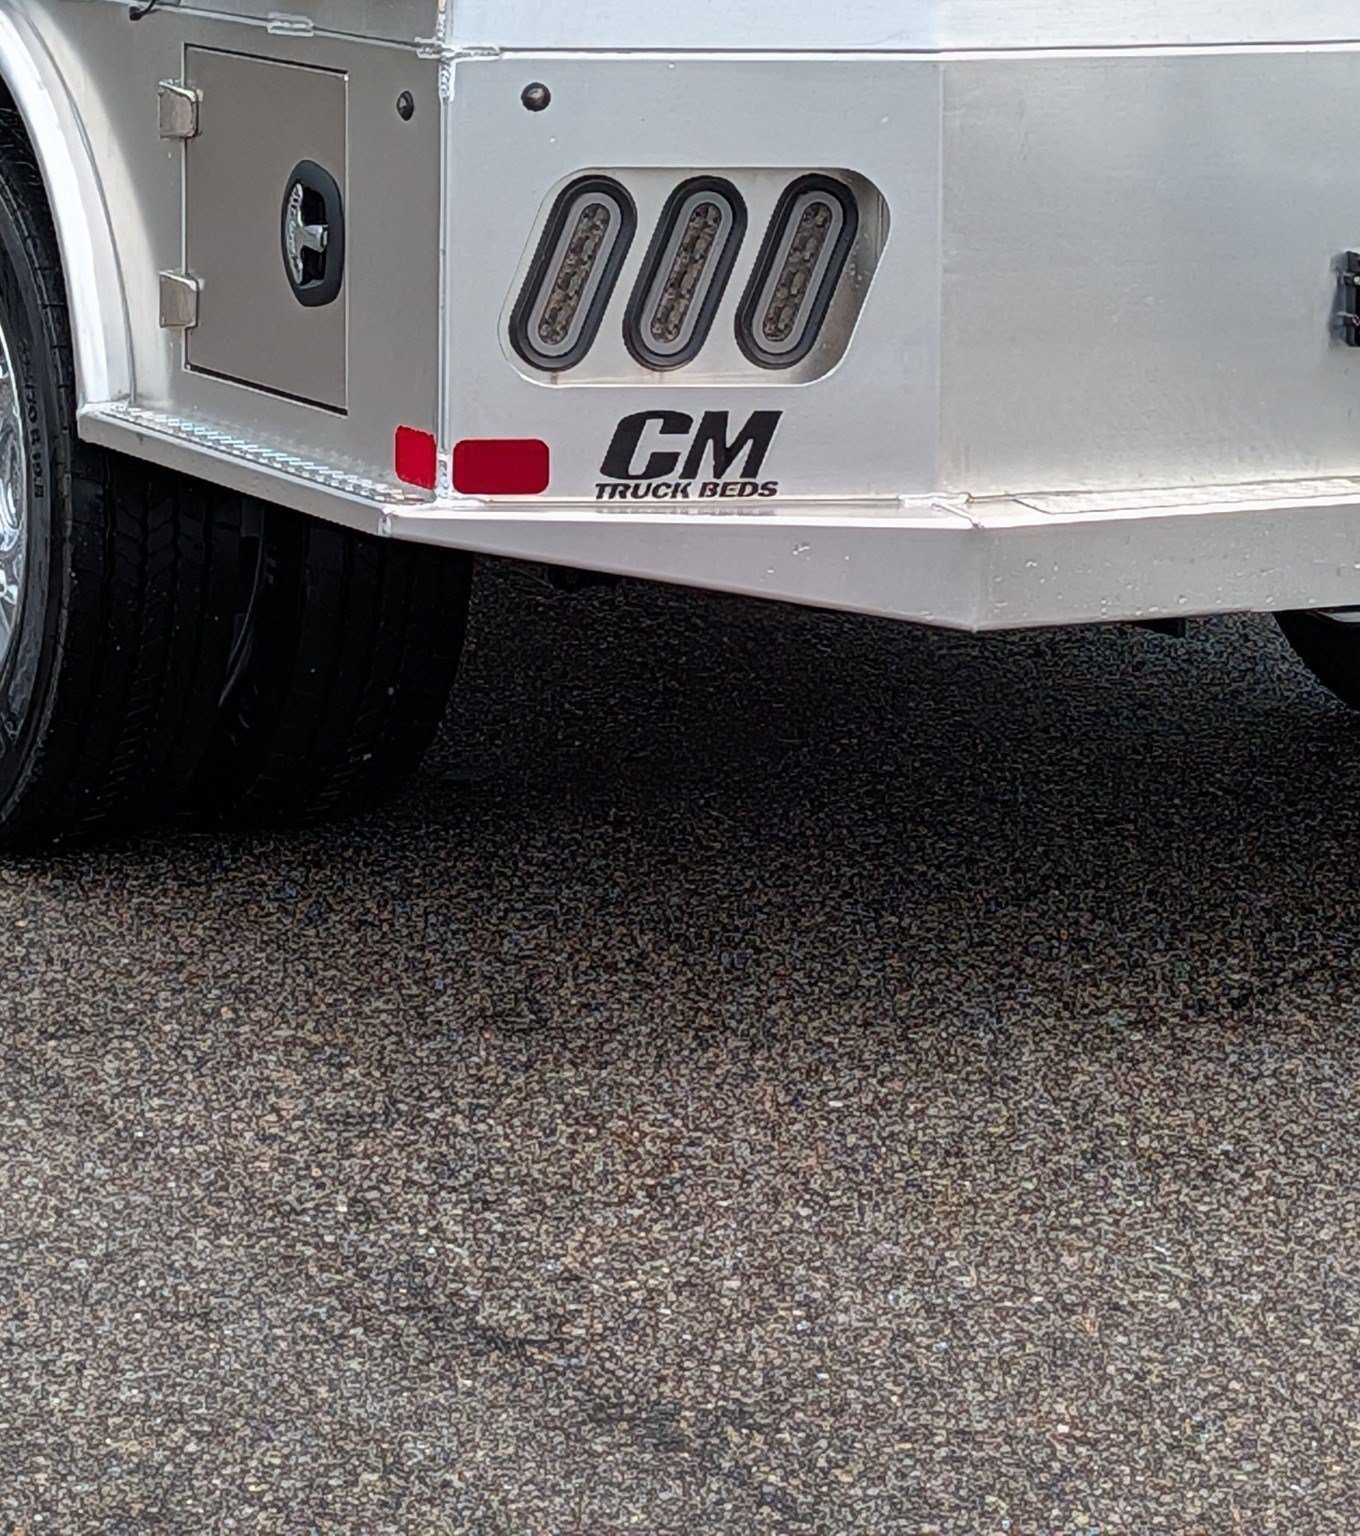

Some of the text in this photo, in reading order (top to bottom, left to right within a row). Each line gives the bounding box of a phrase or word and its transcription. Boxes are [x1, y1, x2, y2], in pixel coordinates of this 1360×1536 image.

[599, 409, 784, 481] CM
[595, 479, 779, 500] TRUCK BEDS
